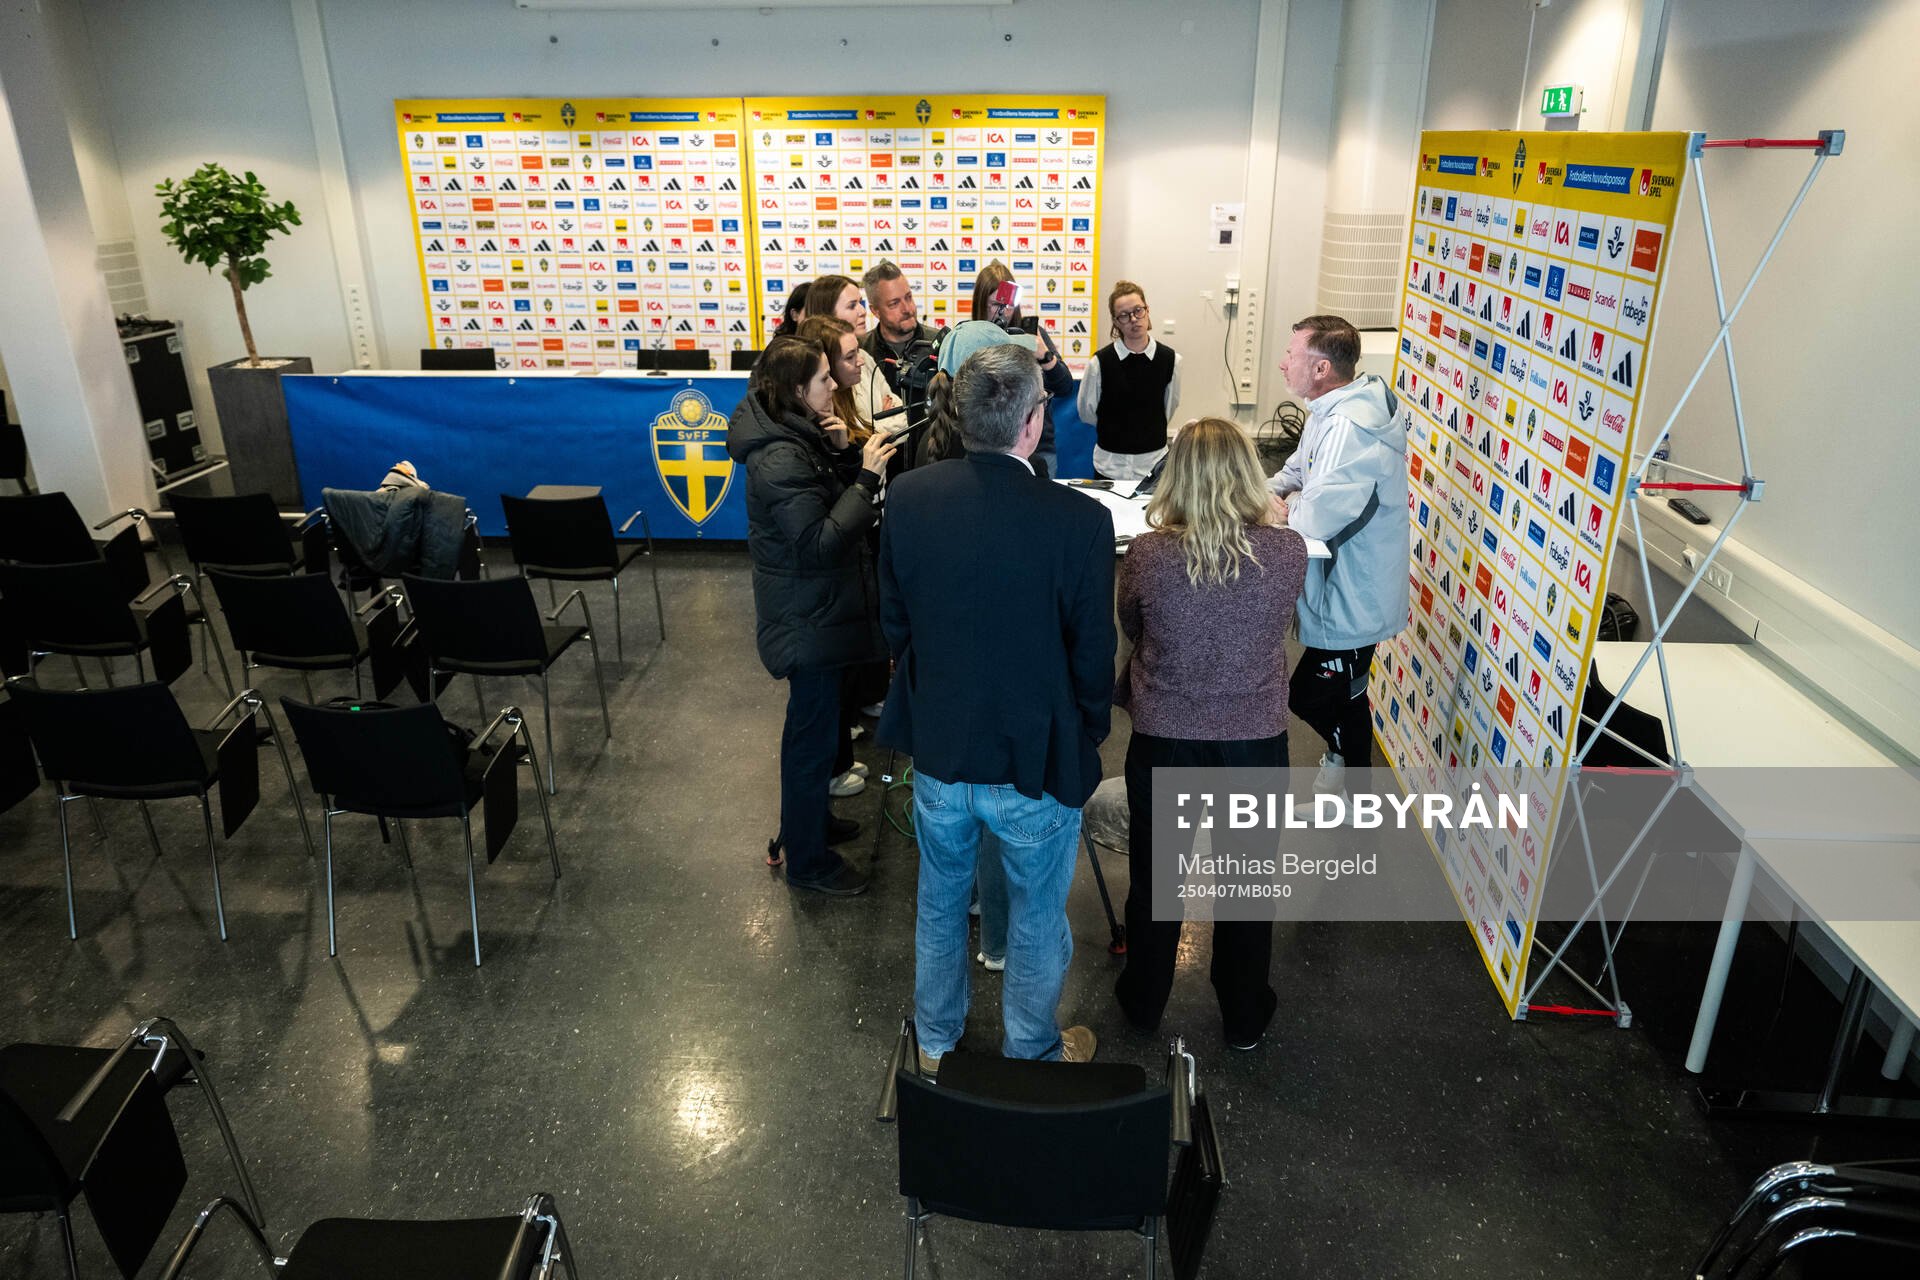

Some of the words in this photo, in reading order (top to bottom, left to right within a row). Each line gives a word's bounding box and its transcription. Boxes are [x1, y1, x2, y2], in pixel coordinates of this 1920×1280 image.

[632, 136, 649, 146] ICA
[870, 135, 891, 145] Fabege
[987, 133, 1004, 143] ICA
[1072, 158, 1093, 166] Fabege
[1546, 167, 1562, 176] SVENSKA
[1544, 177, 1553, 185] SPEL
[1593, 172, 1626, 187] huvudsponsor
[1651, 175, 1674, 187] SVENSKA
[1649, 187, 1662, 197] SPEL
[420, 200, 437, 210] ICA
[665, 200, 682, 209] ICA
[762, 200, 778, 209] ICA
[957, 200, 977, 208] Fabege
[1016, 199, 1032, 208] ICA
[1460, 207, 1472, 218] Scandic
[1476, 209, 1489, 227] Fabege
[531, 221, 547, 230] ICA
[874, 220, 891, 229] ICA
[1555, 221, 1569, 246] ICA
[1614, 226, 1621, 241] SJ
[589, 262, 606, 271] ICA
[725, 262, 740, 271] ICA
[930, 262, 947, 271] ICA
[1041, 263, 1062, 271] Fabege
[1070, 262, 1087, 271] ICA
[1548, 287, 1559, 297] OBOS
[1568, 284, 1591, 301] BAUHAUS
[488, 301, 504, 310] ICA
[647, 302, 663, 311] ICA
[1594, 291, 1617, 309] Scandic
[1406, 302, 1414, 320] ICA
[1623, 298, 1646, 326] Fabege
[521, 359, 537, 368] ICA
[1511, 359, 1525, 382] Fabege
[1582, 361, 1596, 372] SVENSKA
[1596, 368, 1604, 377] SPEL
[1453, 368, 1463, 391] ICA
[1530, 370, 1547, 390] Folksam
[1553, 379, 1567, 407] ICA
[1584, 391, 1591, 405] SJ
[1485, 392, 1499, 411] Coca-Cola
[1603, 408, 1626, 434] Coca-Cola
[677, 431, 710, 440] SvFF
[1543, 430, 1564, 453] BAUHAUS
[1473, 471, 1483, 496] ICA
[1597, 477, 1608, 490] OBOS
[1533, 493, 1544, 506] SVENSKA
[1580, 530, 1594, 545] SVENSKA
[1593, 540, 1602, 553] SPEL
[1501, 547, 1516, 570] Coca-Cola
[1550, 541, 1568, 570] Fabege
[1520, 566, 1537, 591] Folksam
[1574, 560, 1591, 594] ICA
[1495, 586, 1506, 615] ICA
[1512, 608, 1530, 636] Scandic
[1555, 659, 1574, 691] Fabege
[1518, 719, 1535, 748] Scandic
[1427, 764, 1437, 791] ICA
[1530, 791, 1548, 822] Coca-Cola
[1522, 830, 1536, 867] ICA
[1465, 880, 1475, 914] ICA
[1480, 916, 1494, 946] Coca-Cola
